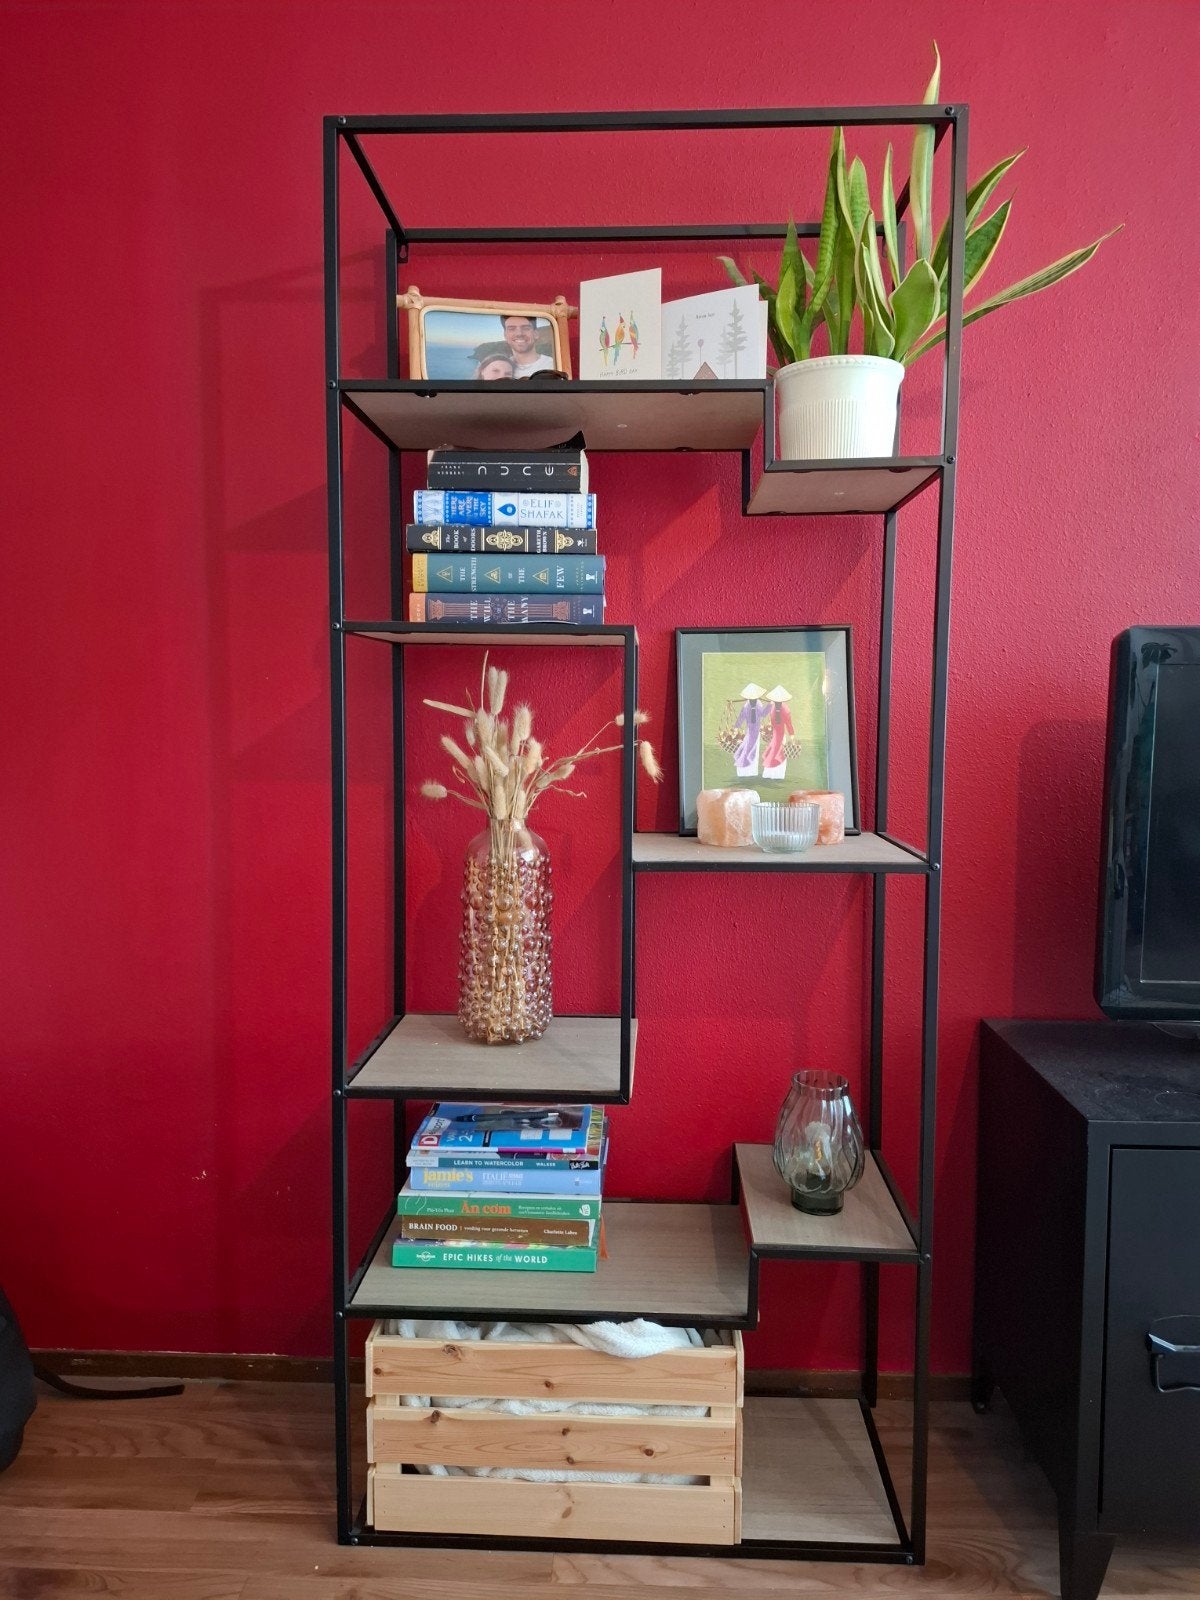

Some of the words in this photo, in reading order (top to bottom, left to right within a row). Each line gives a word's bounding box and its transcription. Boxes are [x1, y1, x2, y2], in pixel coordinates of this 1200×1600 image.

[479, 501, 487, 517] SKY
[530, 499, 554, 508] ELIF
[520, 509, 564, 519] SHAFAK
[556, 565, 565, 588] FEW
[470, 600, 478, 621] THE
[483, 597, 491, 622] WILL
[507, 600, 515, 620] THE
[408, 1222, 434, 1230] BRAIN
[435, 1223, 458, 1231] FOOD
[443, 1253, 463, 1261] EPIC
[467, 1254, 493, 1262] HIKES
[496, 1253, 502, 1262] of
[502, 1254, 512, 1262] the
[515, 1255, 548, 1264] WORLD
